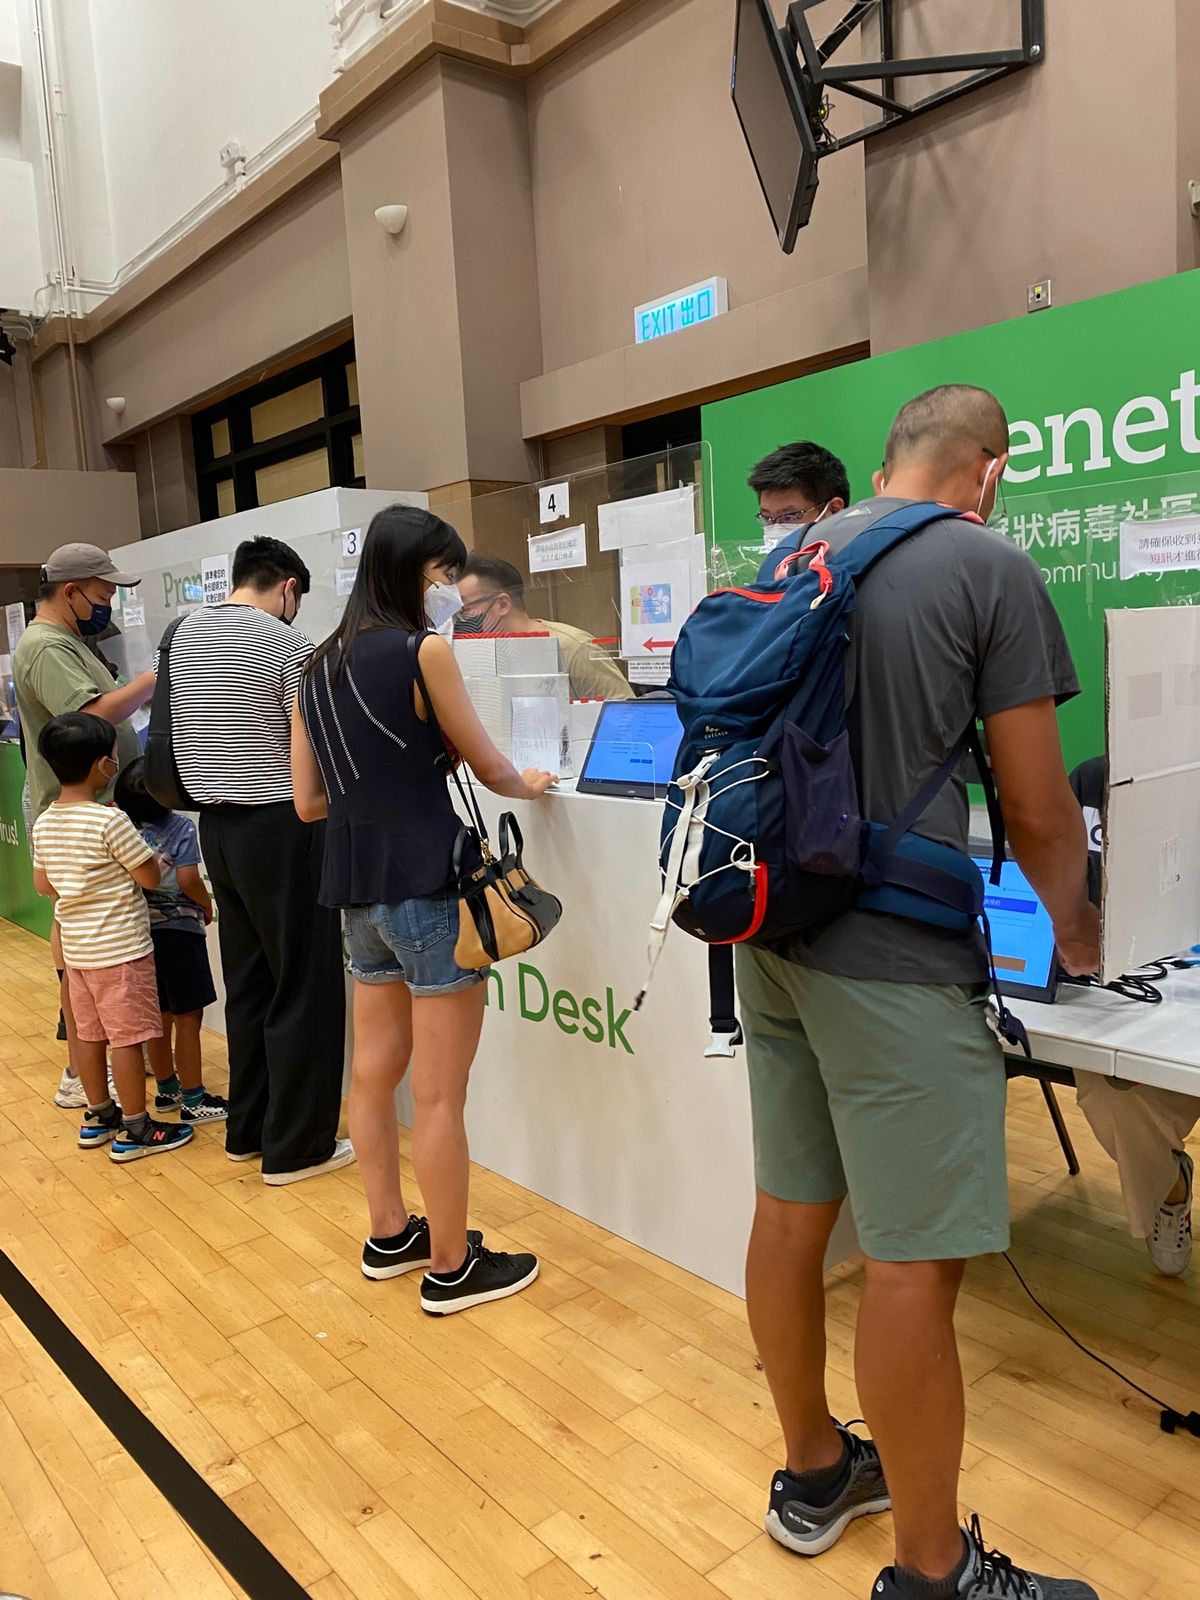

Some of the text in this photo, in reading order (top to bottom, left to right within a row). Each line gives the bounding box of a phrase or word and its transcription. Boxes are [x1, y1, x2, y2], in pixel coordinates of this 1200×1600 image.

[641, 290, 710, 340] EXIT 出口
[547, 493, 557, 513] 4
[347, 531, 357, 555] 3
[1138, 532, 1200, 550] 請確保收到
[518, 961, 636, 1055] Desk
[153, 1130, 167, 1141] N
